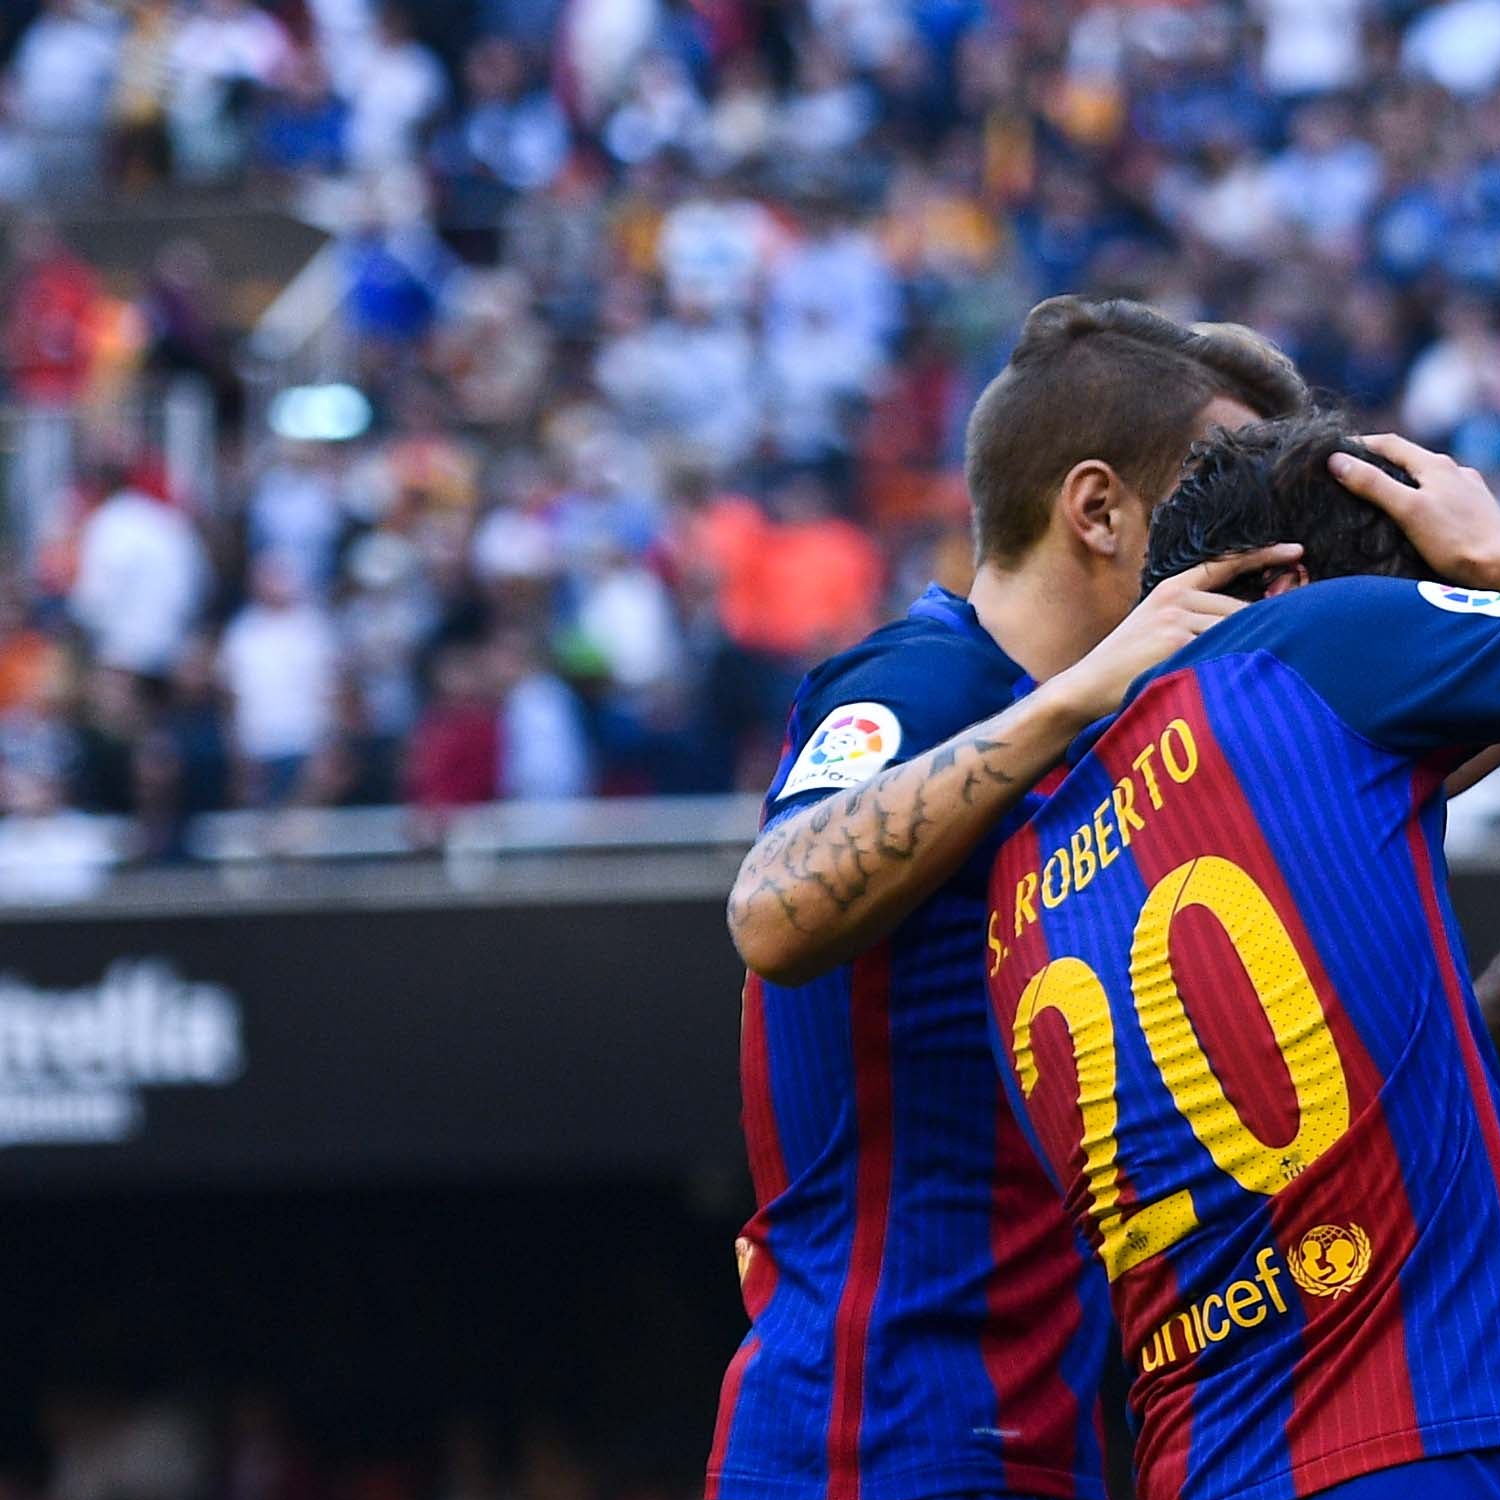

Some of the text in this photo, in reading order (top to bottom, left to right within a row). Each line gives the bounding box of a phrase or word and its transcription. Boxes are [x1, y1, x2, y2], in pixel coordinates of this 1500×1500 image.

[988, 718, 1199, 978] S. ROBERTO
[1012, 855, 1350, 1282] 20
[1141, 1247, 1288, 1373] unicef
